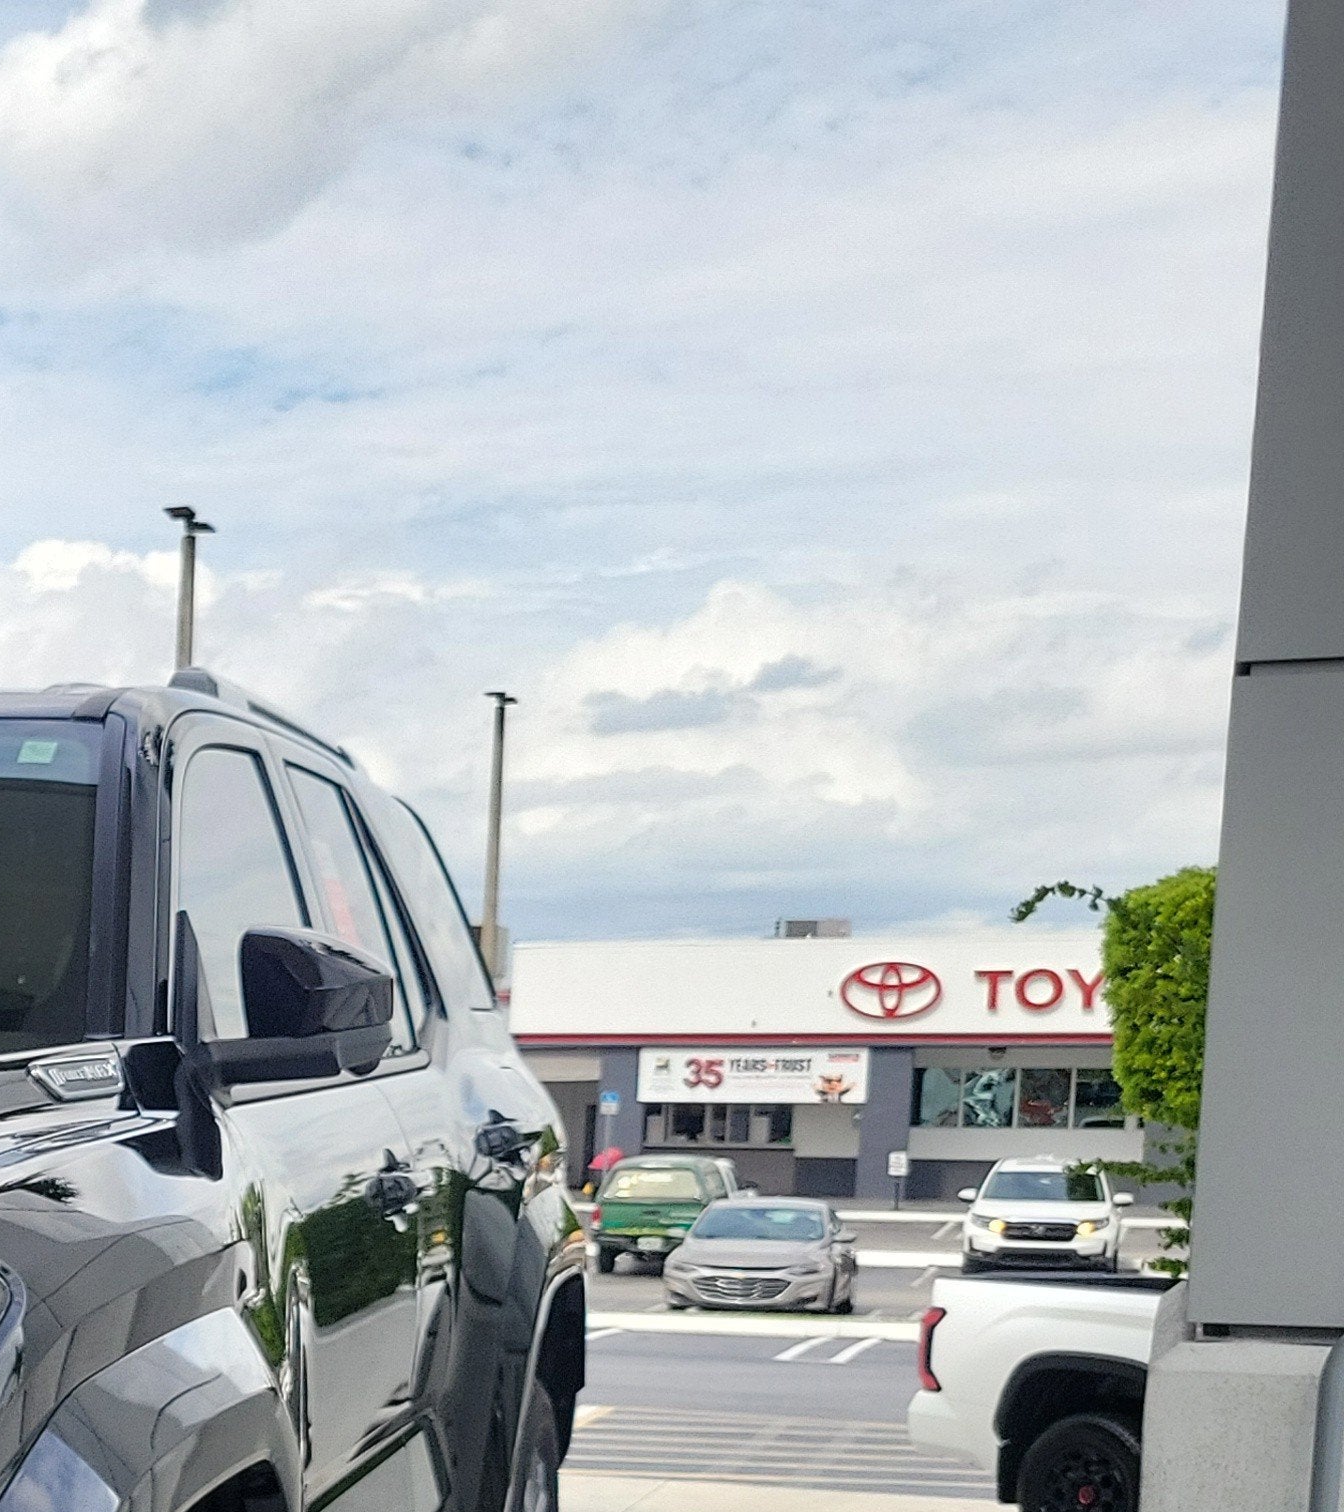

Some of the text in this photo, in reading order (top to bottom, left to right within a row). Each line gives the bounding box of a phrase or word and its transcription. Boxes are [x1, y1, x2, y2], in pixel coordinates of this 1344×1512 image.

[974, 969, 1105, 1011] TOY
[683, 1058, 724, 1088] 35
[729, 1058, 767, 1072] YEARS
